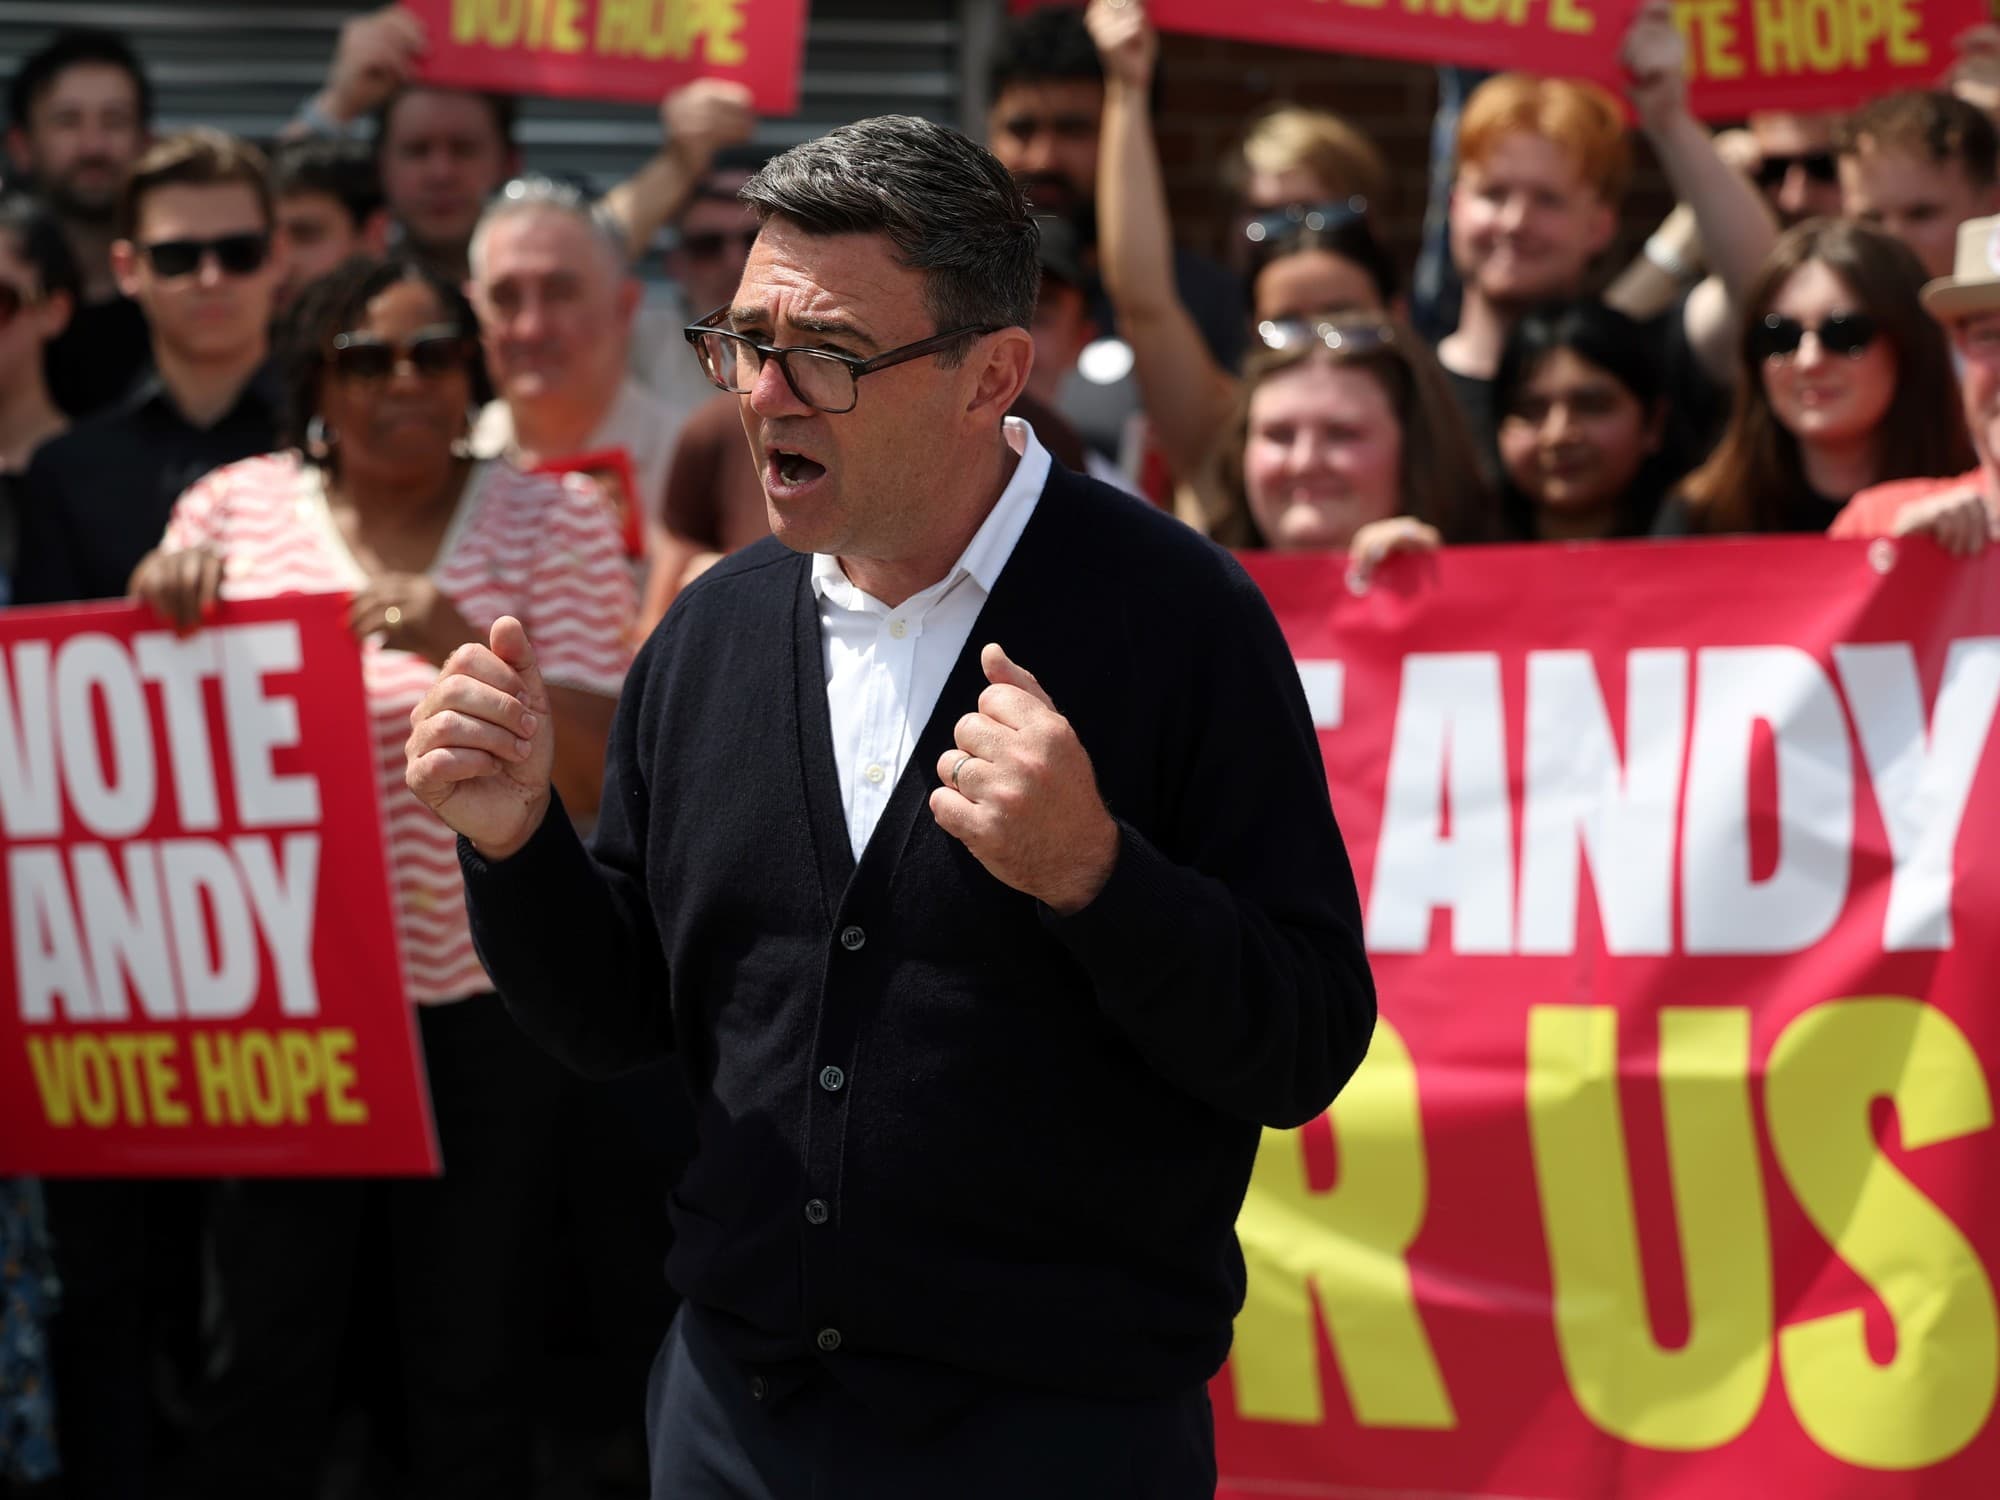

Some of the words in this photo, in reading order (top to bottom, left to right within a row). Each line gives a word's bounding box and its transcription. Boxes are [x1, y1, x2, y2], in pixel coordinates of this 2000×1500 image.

[595, 0, 747, 65] HOPE
[1752, 0, 1928, 73] HOPE
[0, 622, 320, 839] VOTE
[1366, 637, 2000, 955] ANDY
[9, 833, 320, 1021] ANDY
[27, 1035, 189, 1126] VOTE
[192, 1029, 368, 1125] HOPE
[1525, 997, 1999, 1470] US
